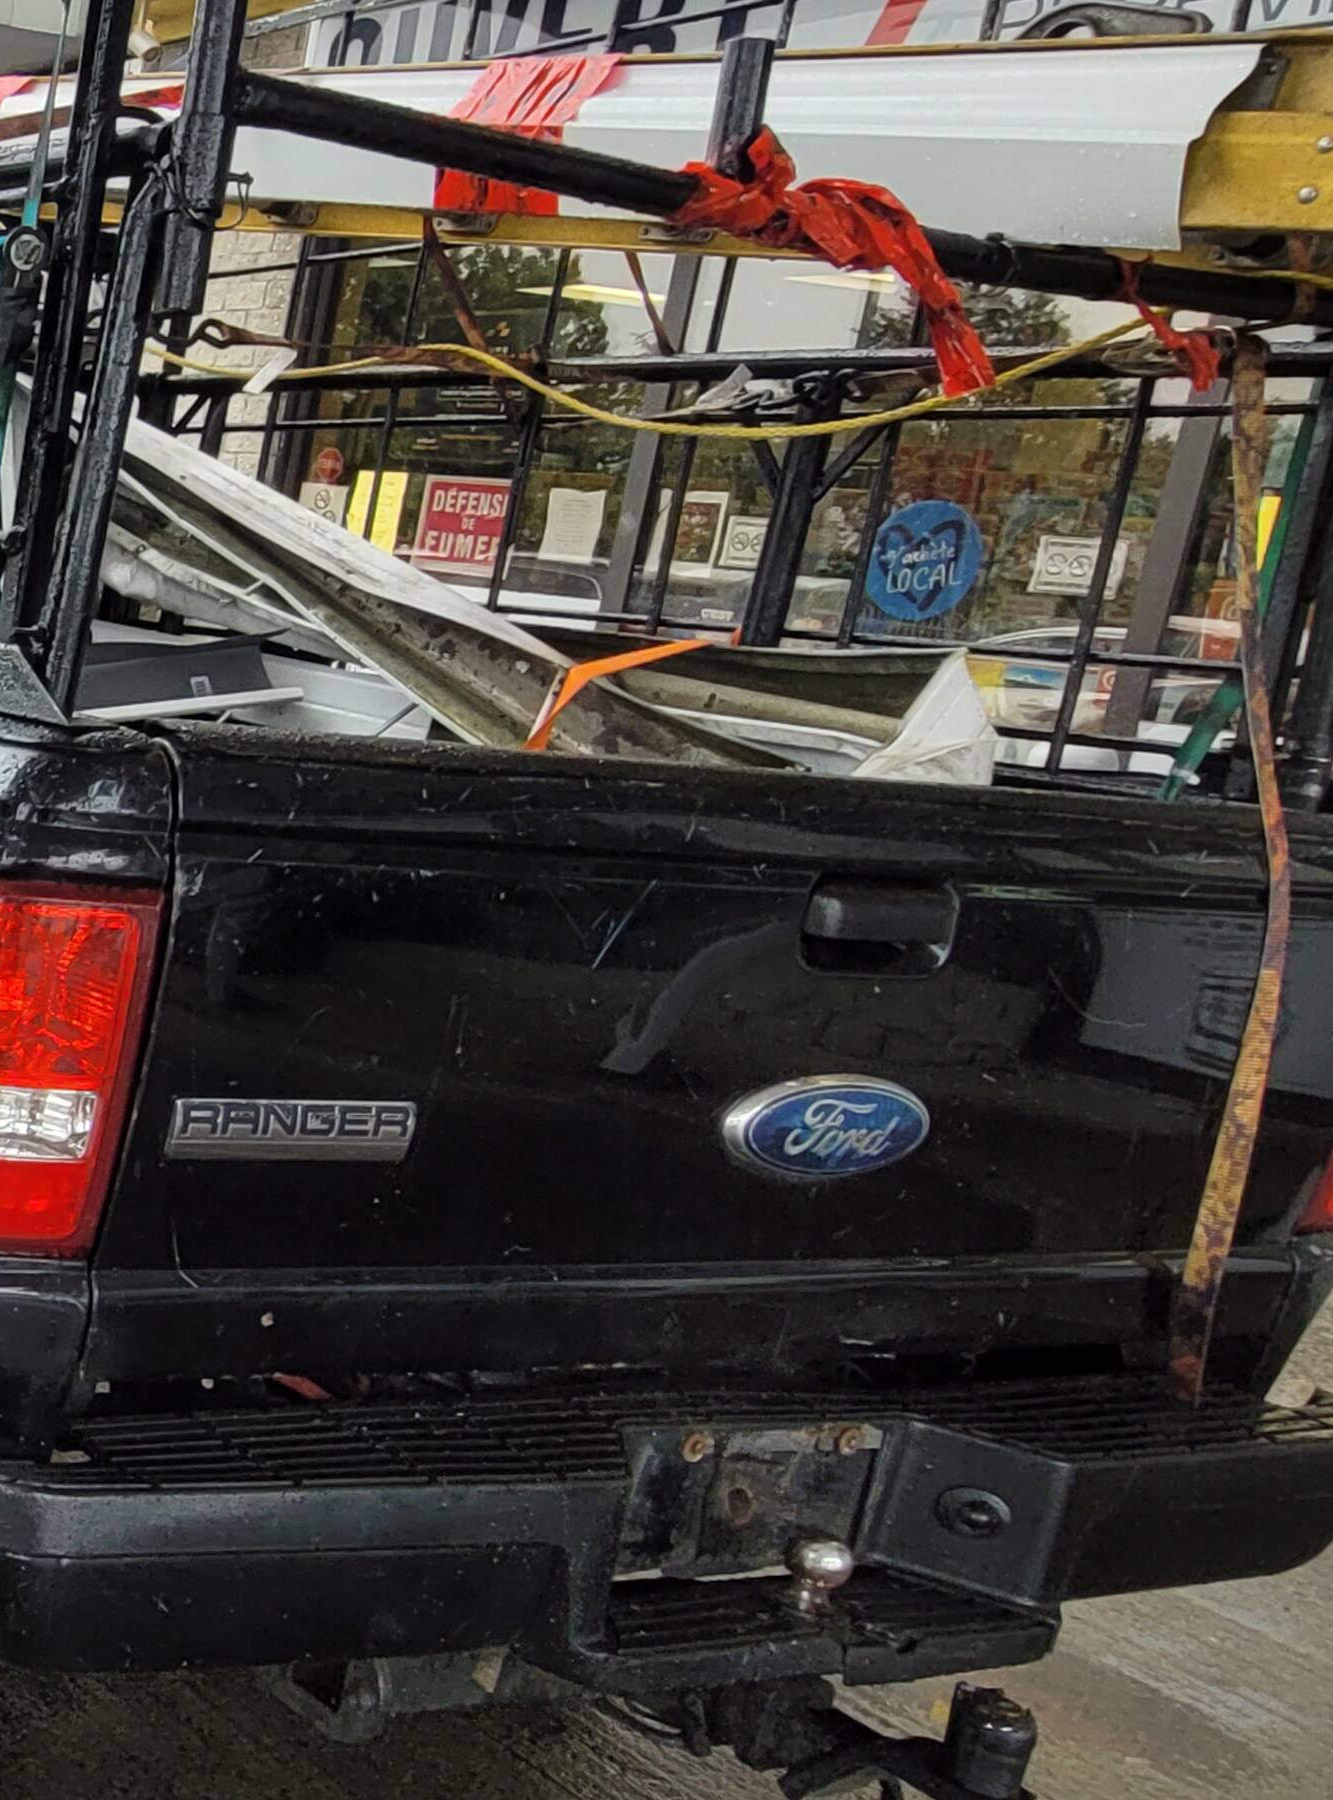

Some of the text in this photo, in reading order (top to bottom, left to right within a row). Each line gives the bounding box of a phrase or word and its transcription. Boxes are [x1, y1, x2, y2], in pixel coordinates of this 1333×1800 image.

[461, 517, 476, 531] DE
[886, 560, 963, 593] LOCAL
[182, 1101, 413, 1138] RANGER
[783, 1099, 901, 1158] Ford
